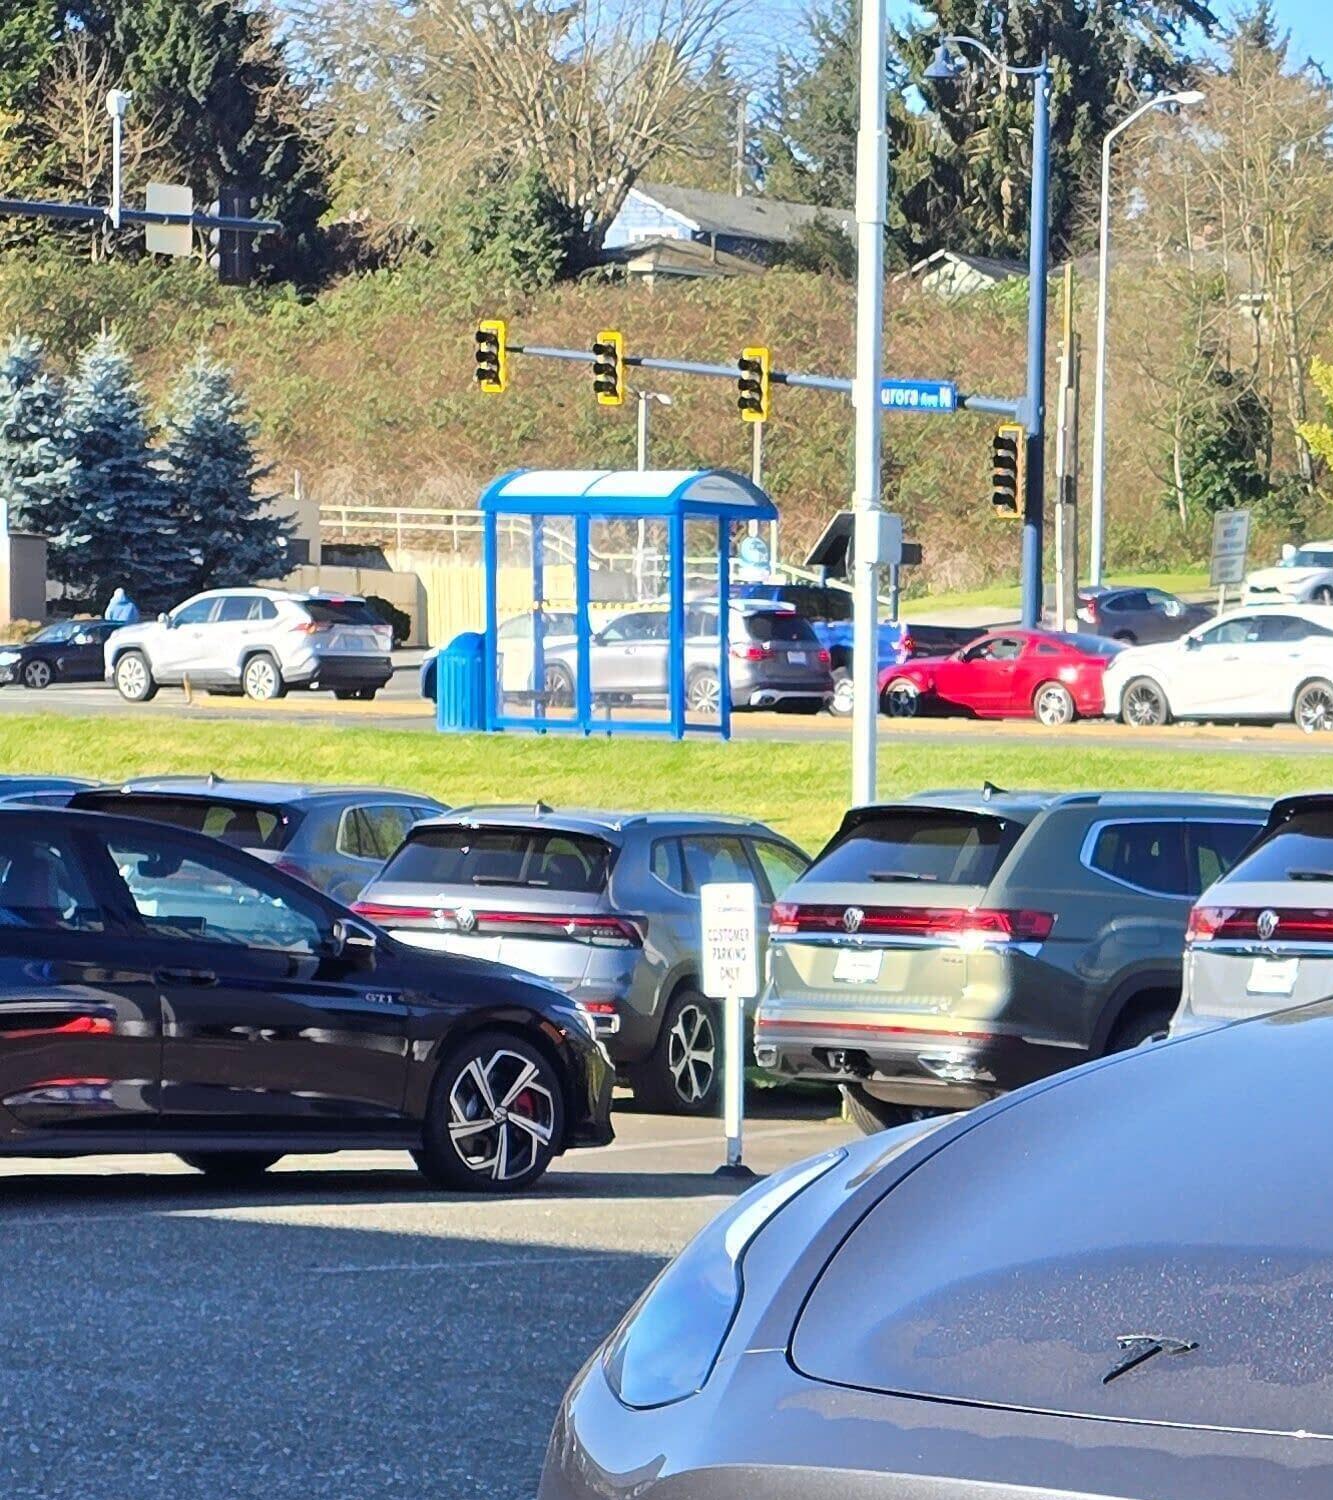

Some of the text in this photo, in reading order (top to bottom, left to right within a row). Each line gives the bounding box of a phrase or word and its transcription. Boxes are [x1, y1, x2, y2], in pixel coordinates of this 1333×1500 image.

[880, 388, 918, 406] urora
[939, 387, 951, 408] N
[708, 928, 750, 942] CUSTOMER
[712, 947, 746, 961] PARKING
[720, 967, 740, 981] ONLY
